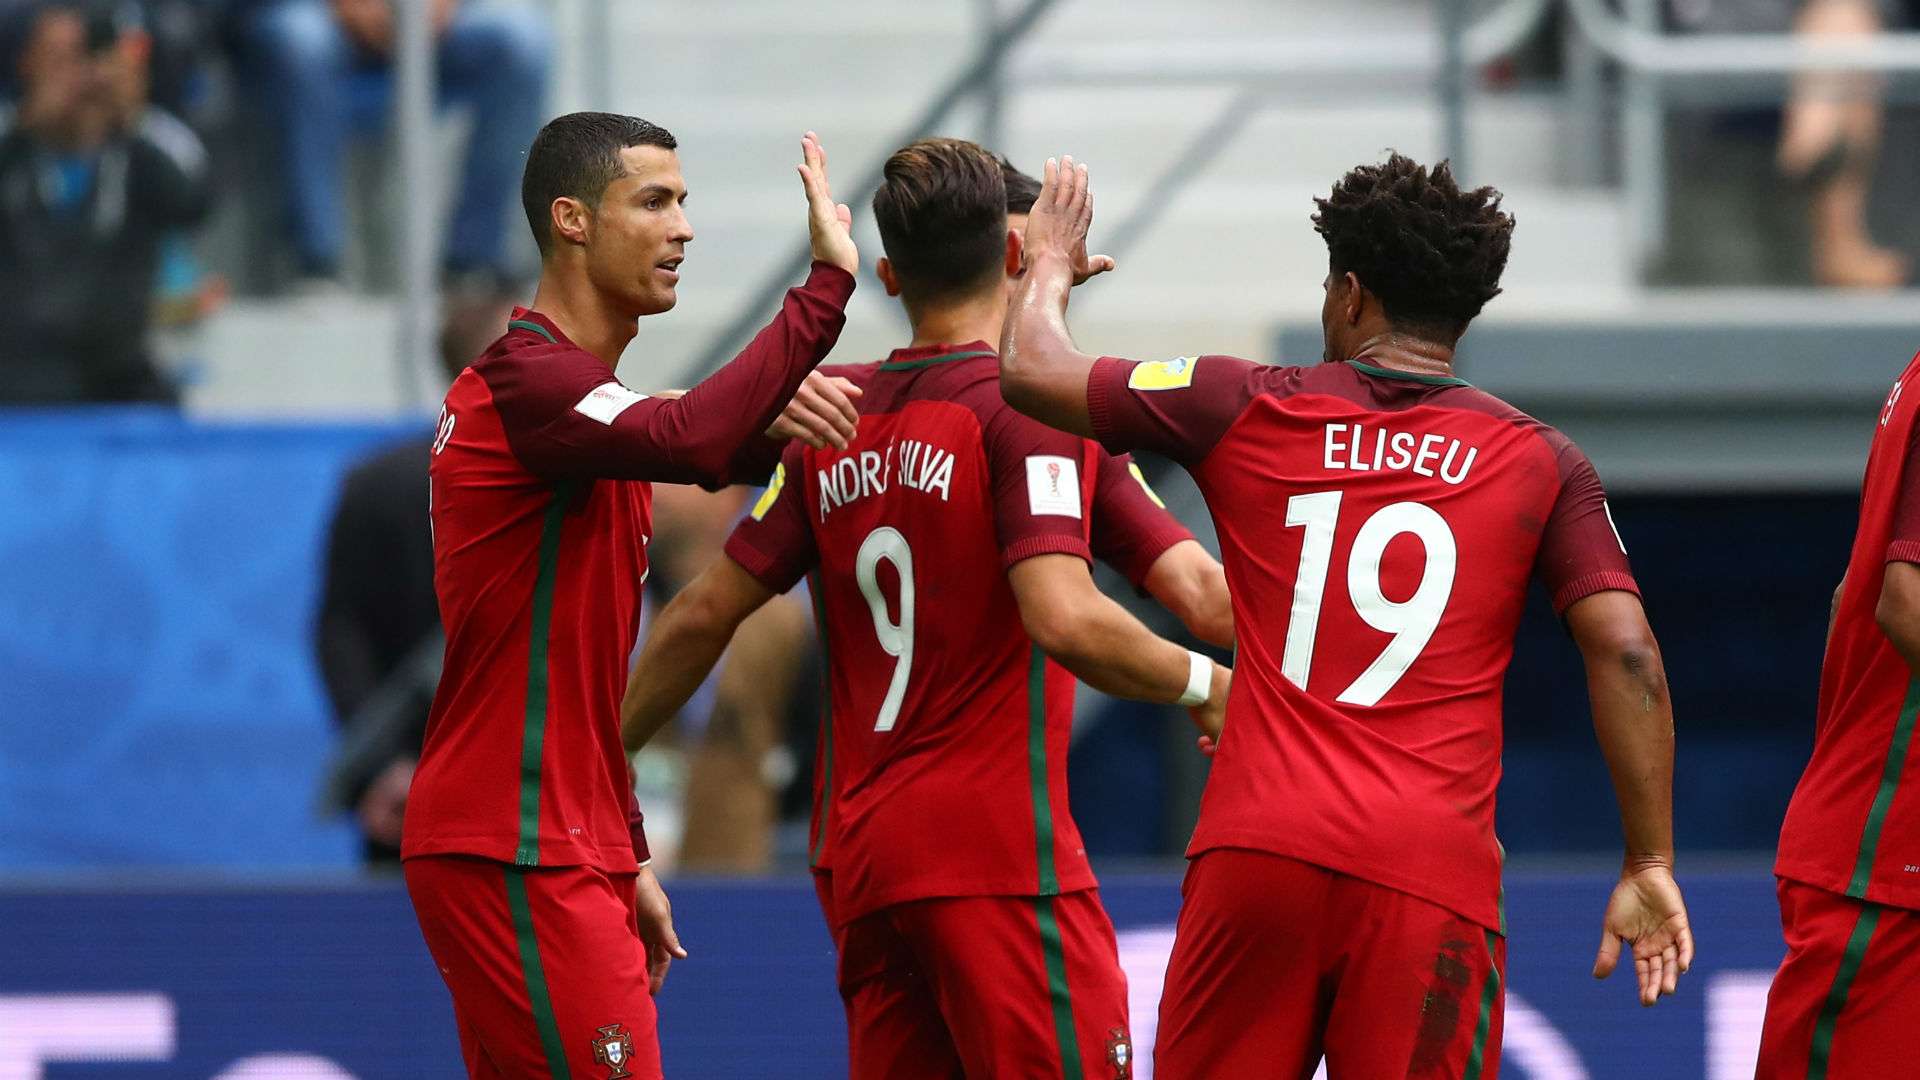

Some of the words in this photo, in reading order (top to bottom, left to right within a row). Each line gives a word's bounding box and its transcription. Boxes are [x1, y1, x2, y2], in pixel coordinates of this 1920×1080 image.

[898, 440, 955, 501] SILVA
[1323, 423, 1478, 485] ELISEU
[855, 526, 915, 732] 9
[1281, 490, 1457, 707] 19
